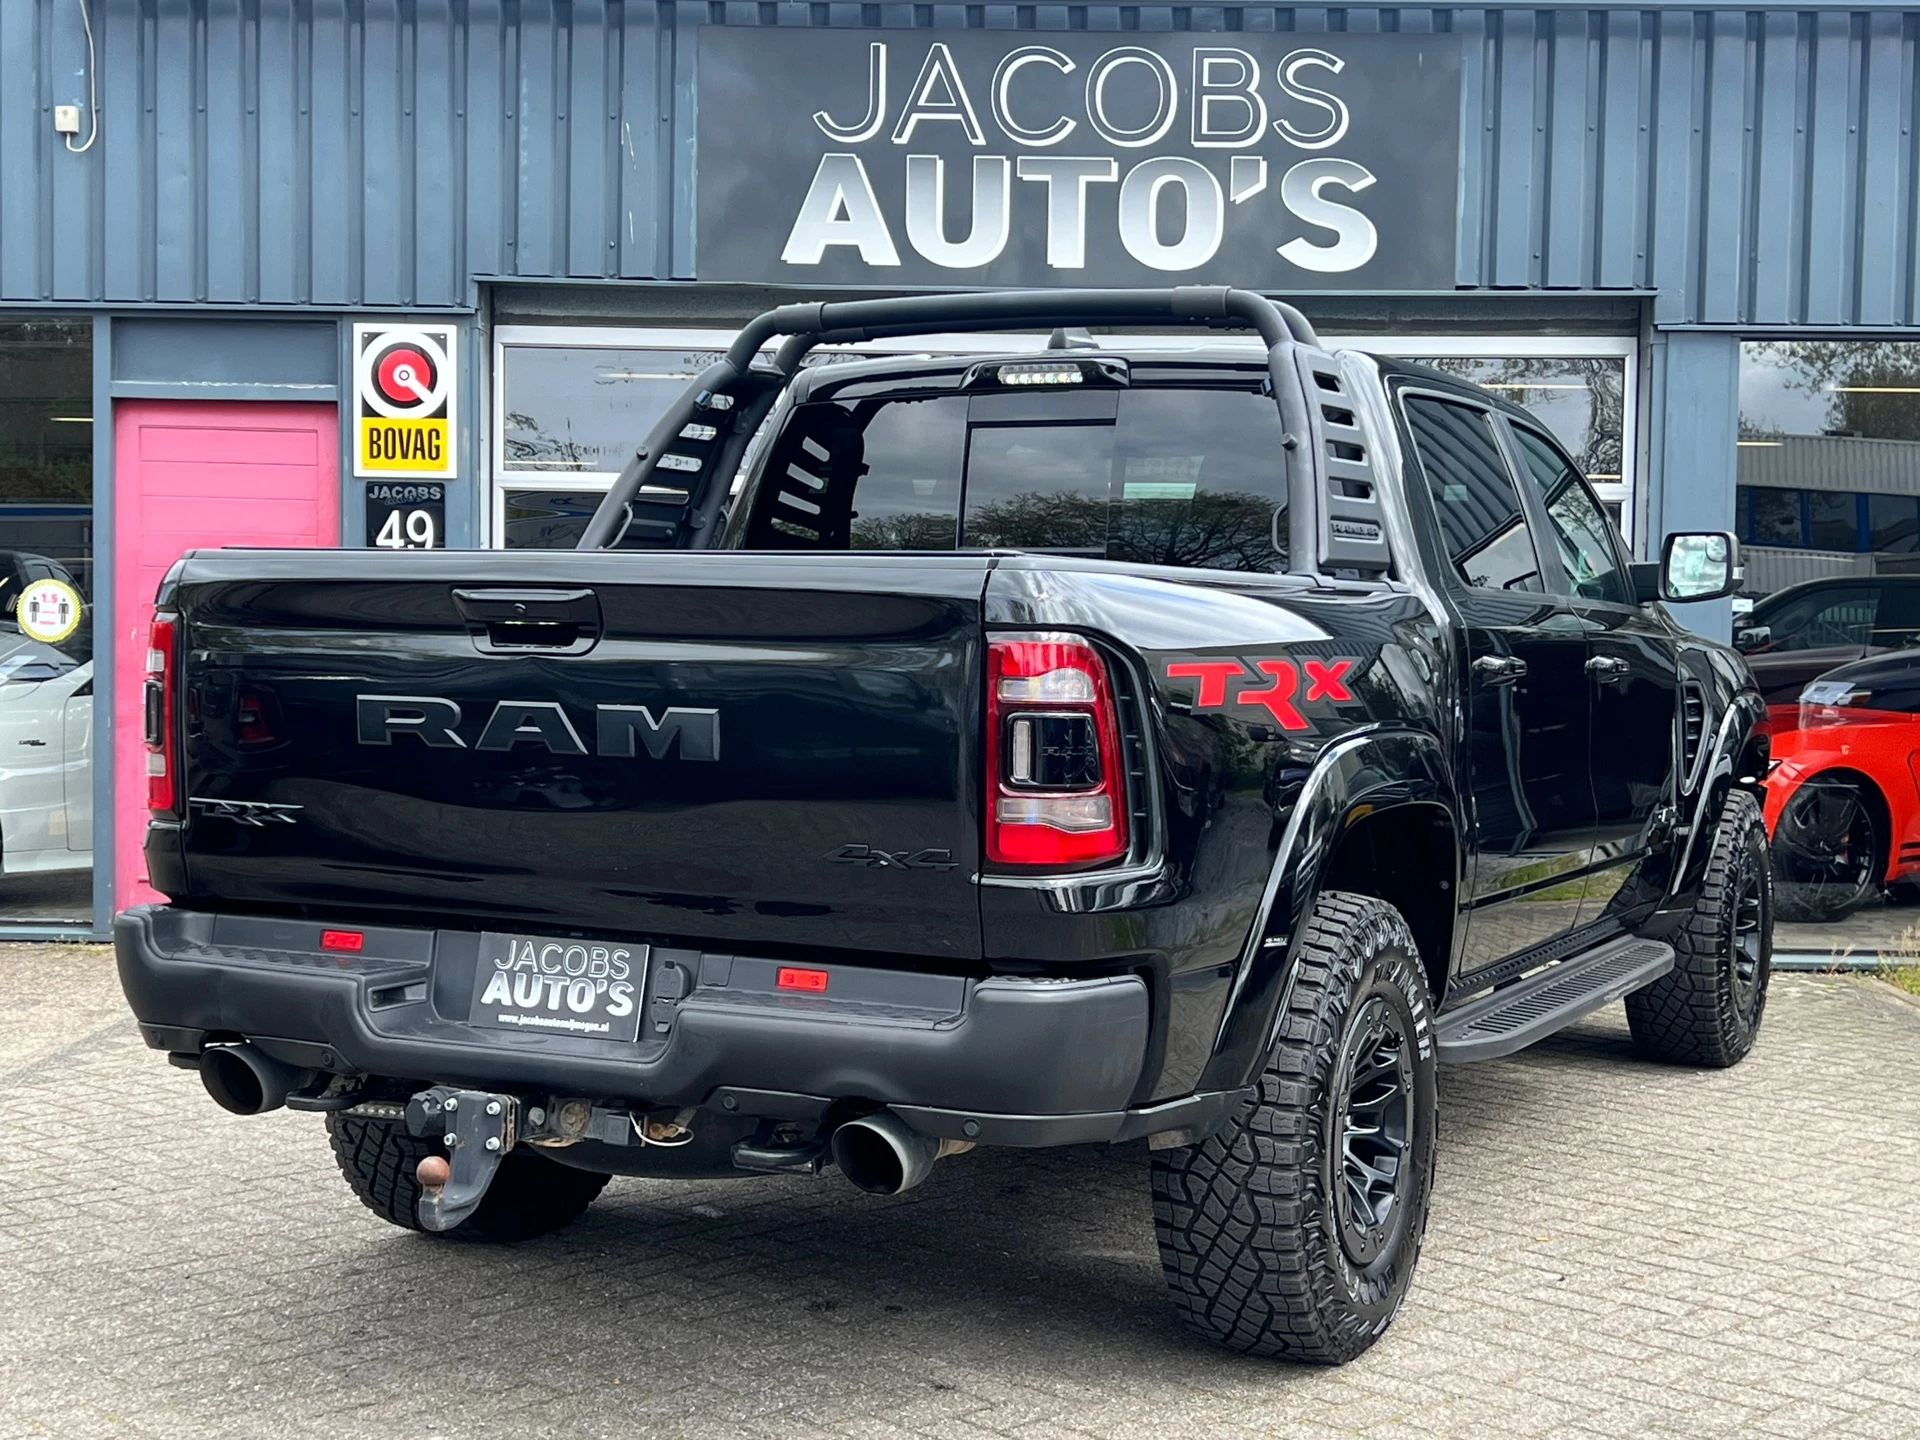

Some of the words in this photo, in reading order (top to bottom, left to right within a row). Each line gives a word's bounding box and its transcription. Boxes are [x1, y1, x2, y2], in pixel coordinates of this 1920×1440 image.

[812, 42, 1350, 149] JACOBS
[780, 153, 1379, 273] AUTO'S
[369, 427, 441, 460] BOVAG
[368, 486, 441, 500] JACOBS
[375, 509, 434, 549] 49
[1166, 660, 1354, 731] TRX
[356, 694, 721, 762] RAM
[494, 939, 631, 980] JACOBS
[480, 970, 635, 1017] AUTO'S
